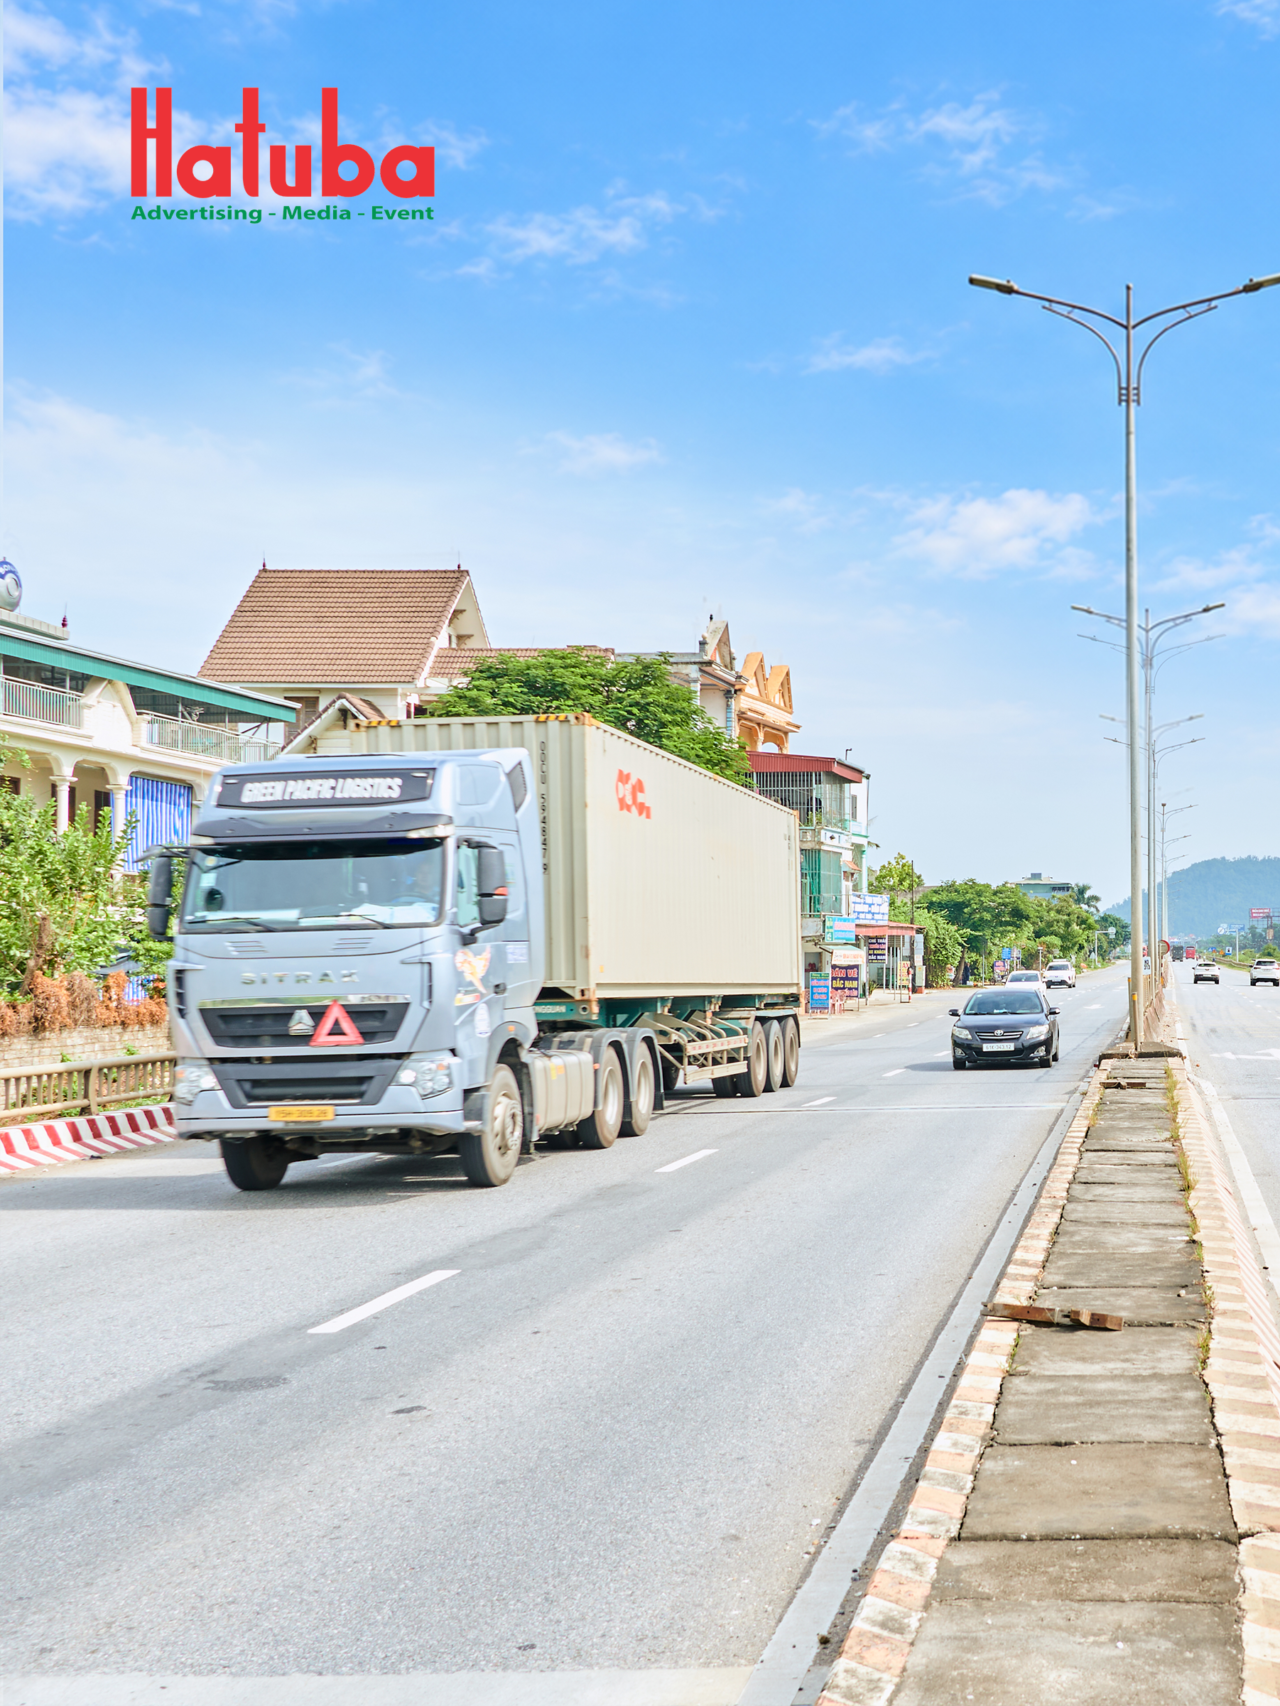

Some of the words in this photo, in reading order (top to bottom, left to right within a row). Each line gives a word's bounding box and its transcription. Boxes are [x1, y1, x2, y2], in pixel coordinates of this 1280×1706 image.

[241, 781, 286, 803] GREEN
[284, 779, 336, 800] PACIFIC
[334, 778, 402, 798] LOGISTICS
